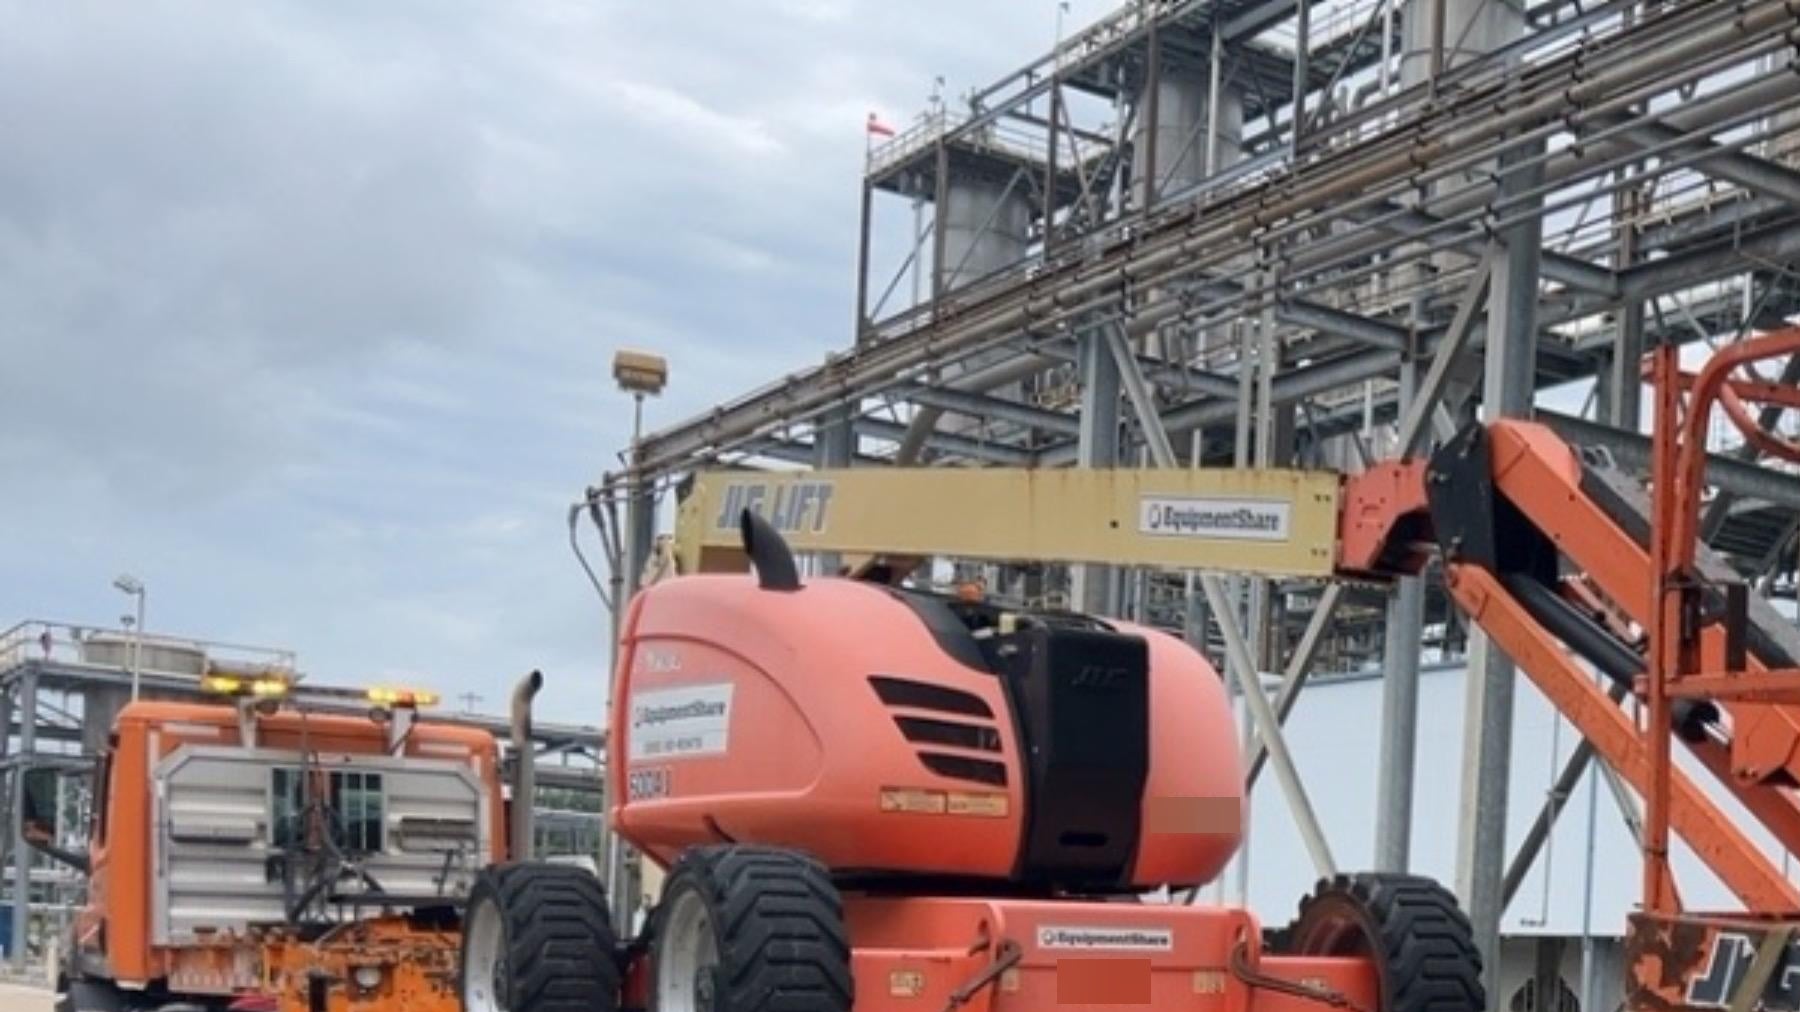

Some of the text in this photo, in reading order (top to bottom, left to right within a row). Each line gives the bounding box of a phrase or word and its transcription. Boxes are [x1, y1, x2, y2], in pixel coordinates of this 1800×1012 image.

[770, 483, 834, 533] LIFT
[1163, 505, 1280, 532] EquipmentShare
[1057, 931, 1168, 945] EquipmentShare
